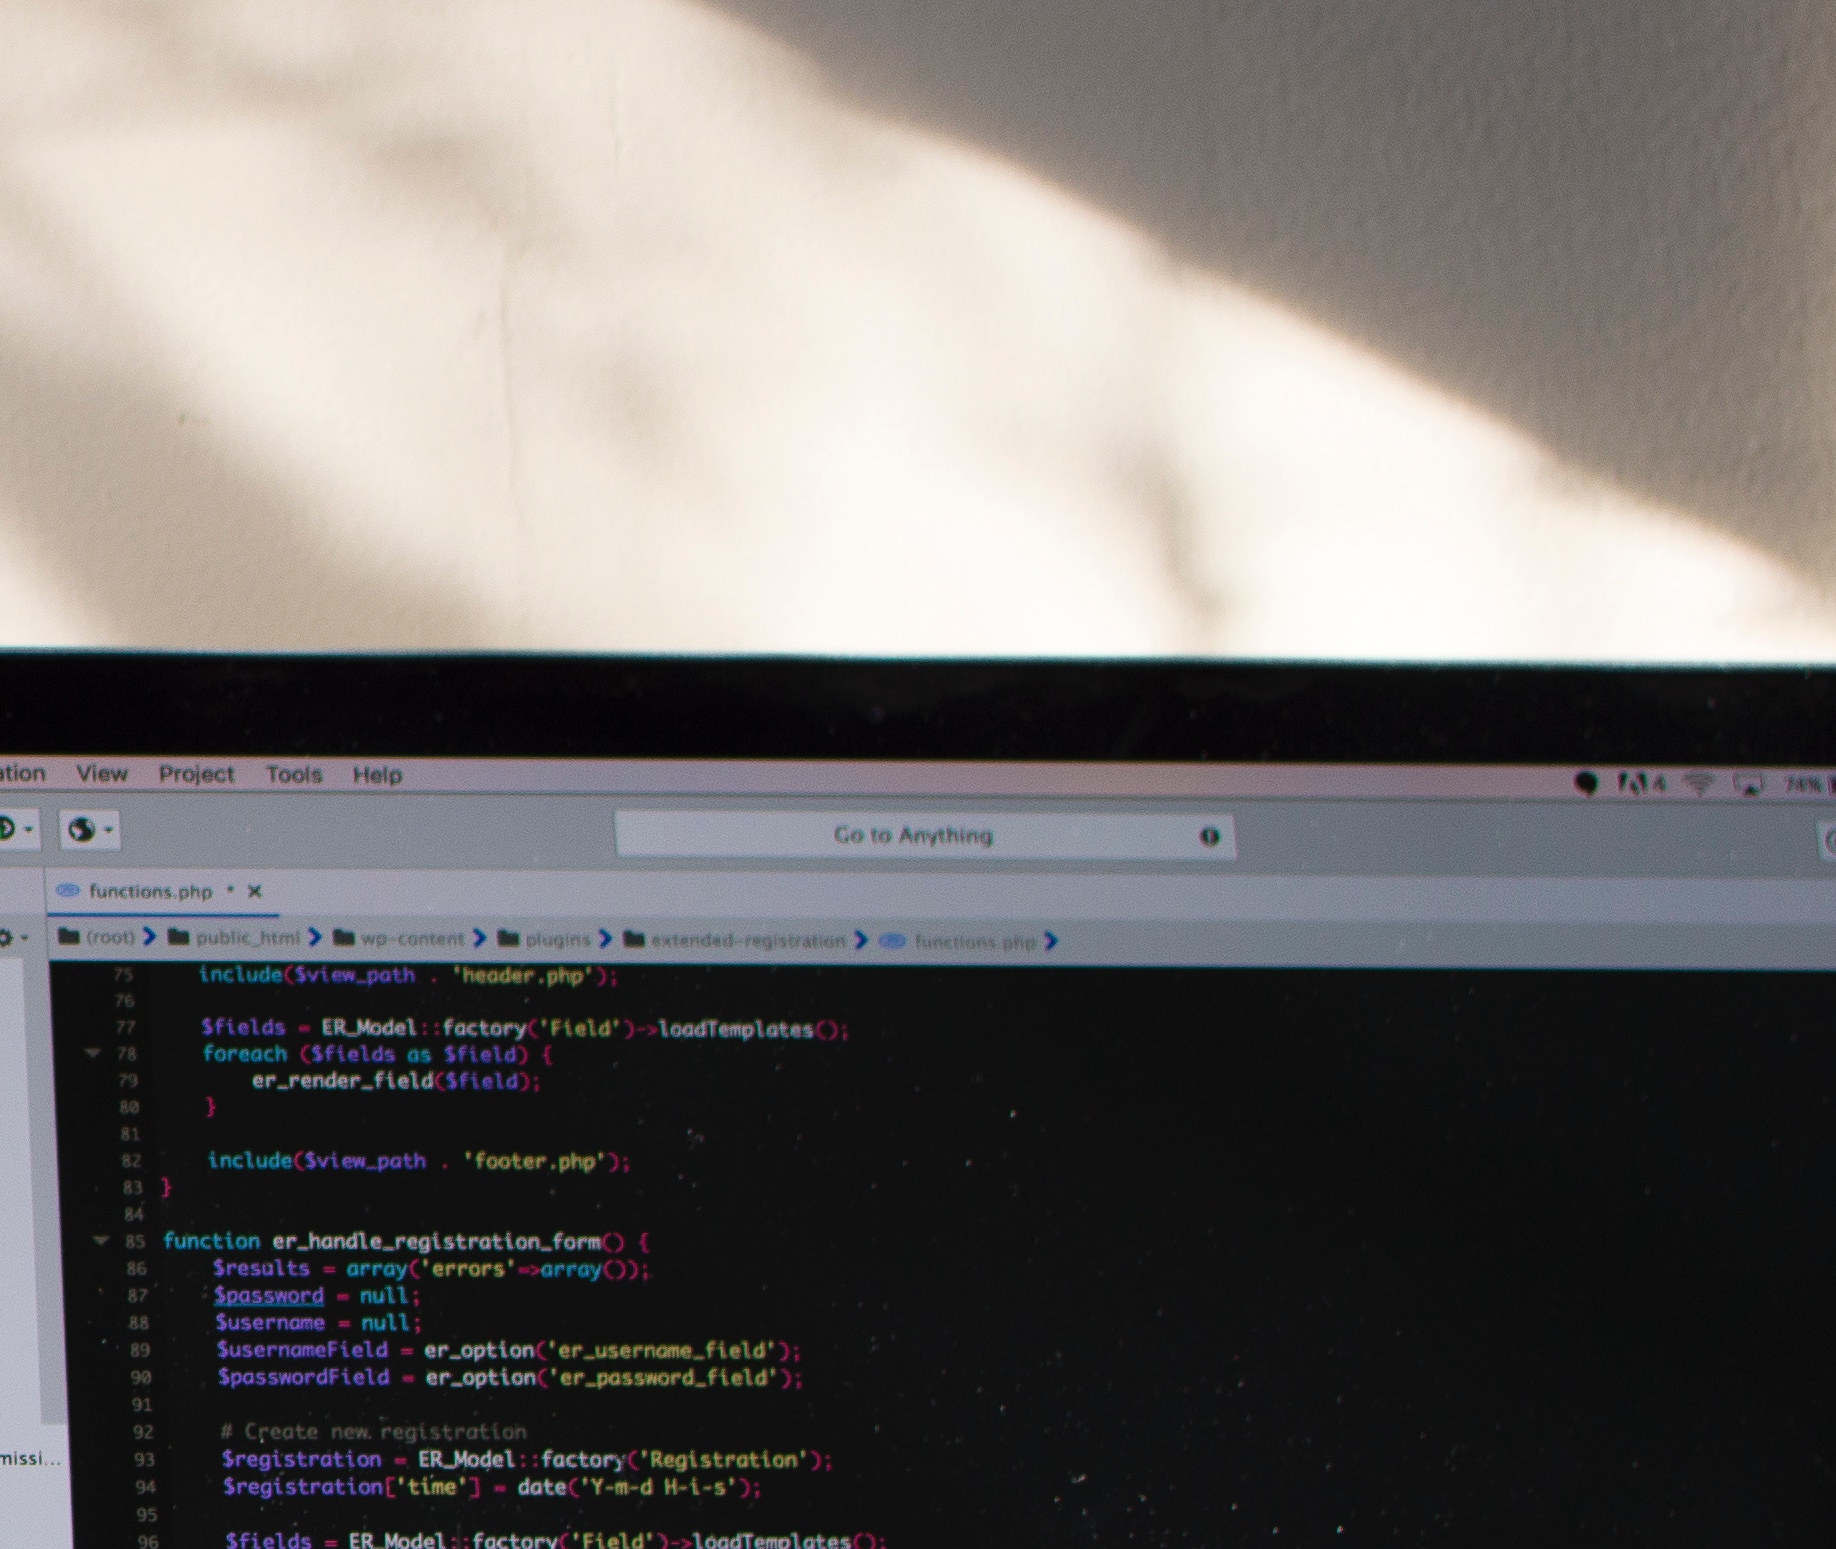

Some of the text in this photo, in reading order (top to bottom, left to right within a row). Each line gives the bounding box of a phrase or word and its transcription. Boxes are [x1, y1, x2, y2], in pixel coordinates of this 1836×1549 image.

[77, 765, 128, 782] View
[160, 765, 235, 786] Project
[268, 765, 322, 784] Tools
[354, 765, 402, 787] Help
[831, 826, 993, 847] Go to Anything
[90, 883, 212, 902] functions.php
[204, 1045, 287, 1062] foreach
[407, 1050, 431, 1063] as
[164, 1233, 260, 1250] function
[245, 1423, 526, 1443] Create new registration
